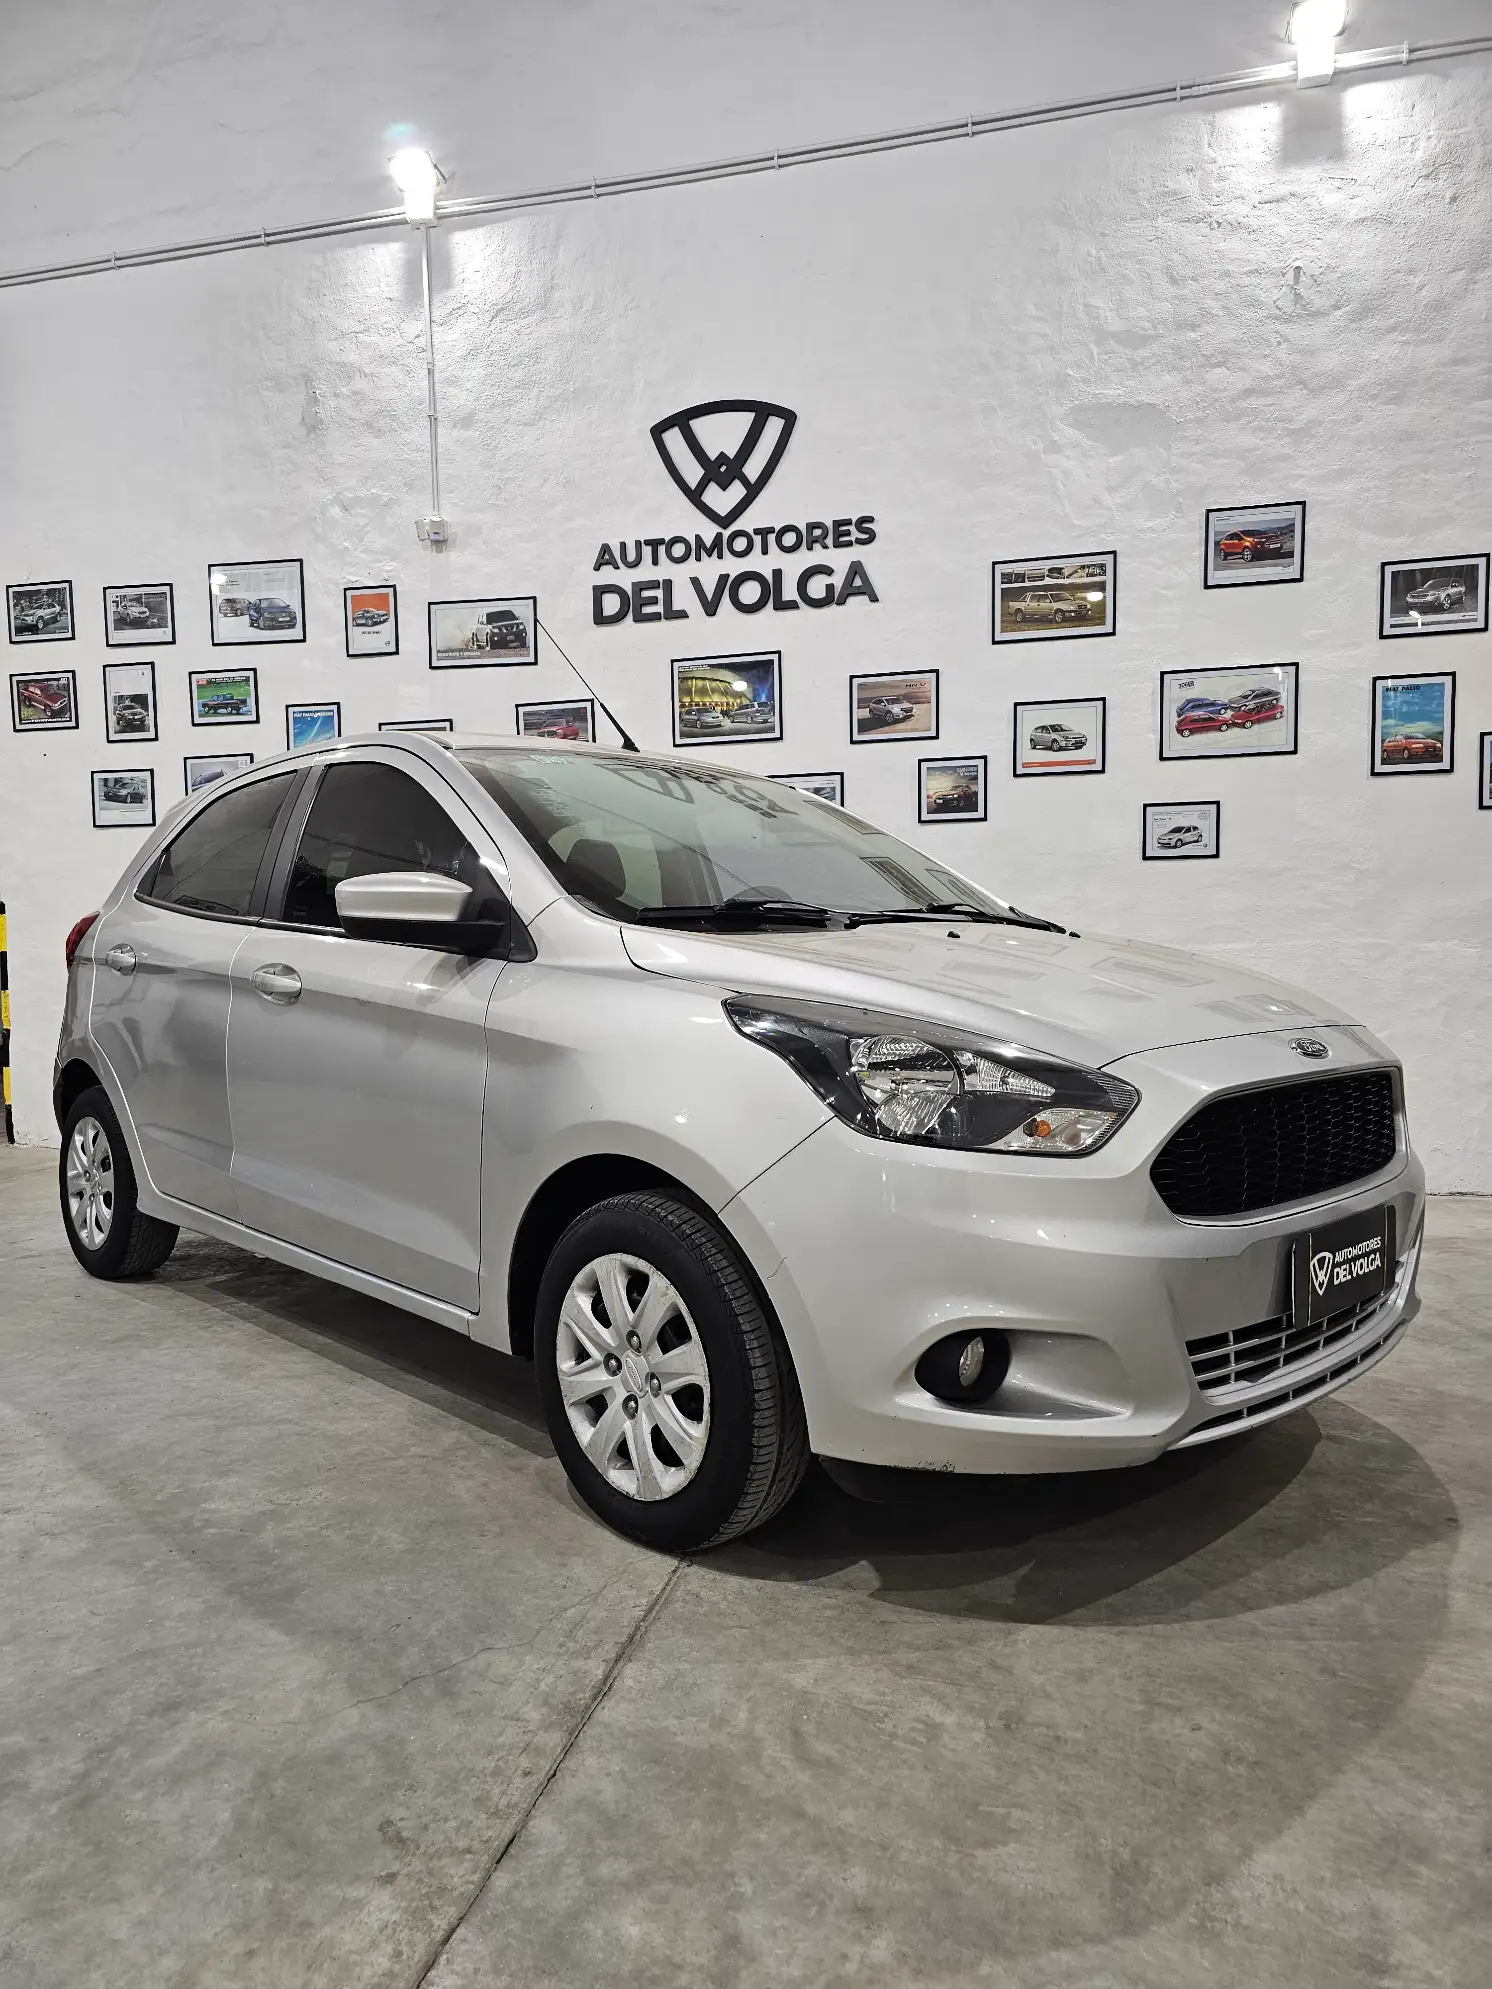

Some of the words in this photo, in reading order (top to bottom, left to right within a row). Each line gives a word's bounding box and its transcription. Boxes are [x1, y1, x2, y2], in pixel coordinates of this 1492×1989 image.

[592, 515, 877, 572] AUTOMOTORES
[592, 578, 690, 626] DEL
[689, 560, 880, 617] VOLGA
[1333, 1264, 1352, 1286] DEL
[1351, 1251, 1382, 1278] VOLGA
[1334, 1236, 1382, 1264] AUTOMOTORES
